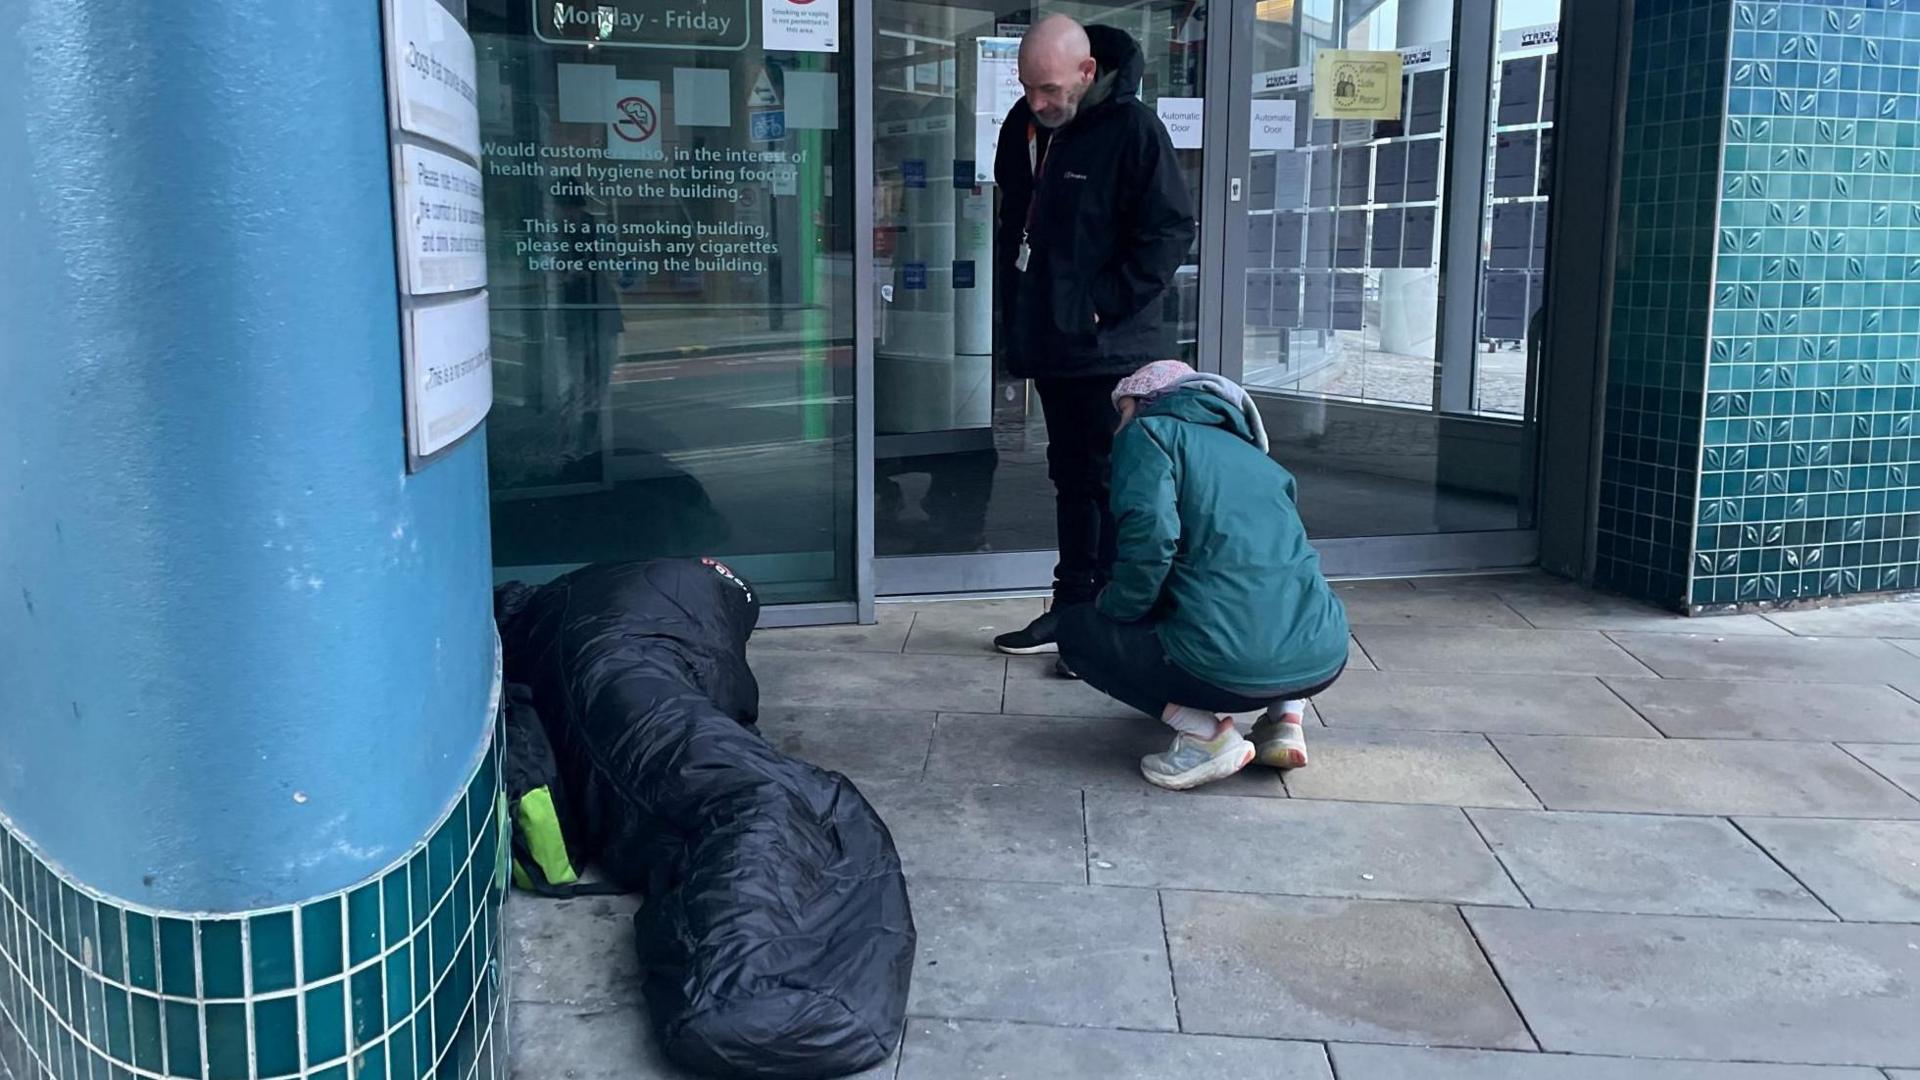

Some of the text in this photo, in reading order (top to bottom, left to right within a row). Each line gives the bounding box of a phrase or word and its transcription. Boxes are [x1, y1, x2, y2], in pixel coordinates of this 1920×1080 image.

[772, 8, 800, 17] Smoking
[665, 10, 731, 36] Friday
[1161, 111, 1201, 121] Automatic
[1254, 113, 1292, 122] Automatic
[1171, 123, 1190, 132] Door
[1264, 125, 1282, 134] Door
[481, 141, 536, 158] Would
[674, 146, 690, 161] in
[695, 147, 723, 162] the
[726, 148, 787, 163] interest
[791, 149, 808, 164] of
[490, 161, 798, 184] health and hygiene not bring food or
[550, 181, 743, 203] drink into the building.
[523, 218, 770, 240] This is a no smoking building,
[516, 238, 779, 258] please extinguish any cigarettes
[528, 256, 768, 276] before entering the building.
